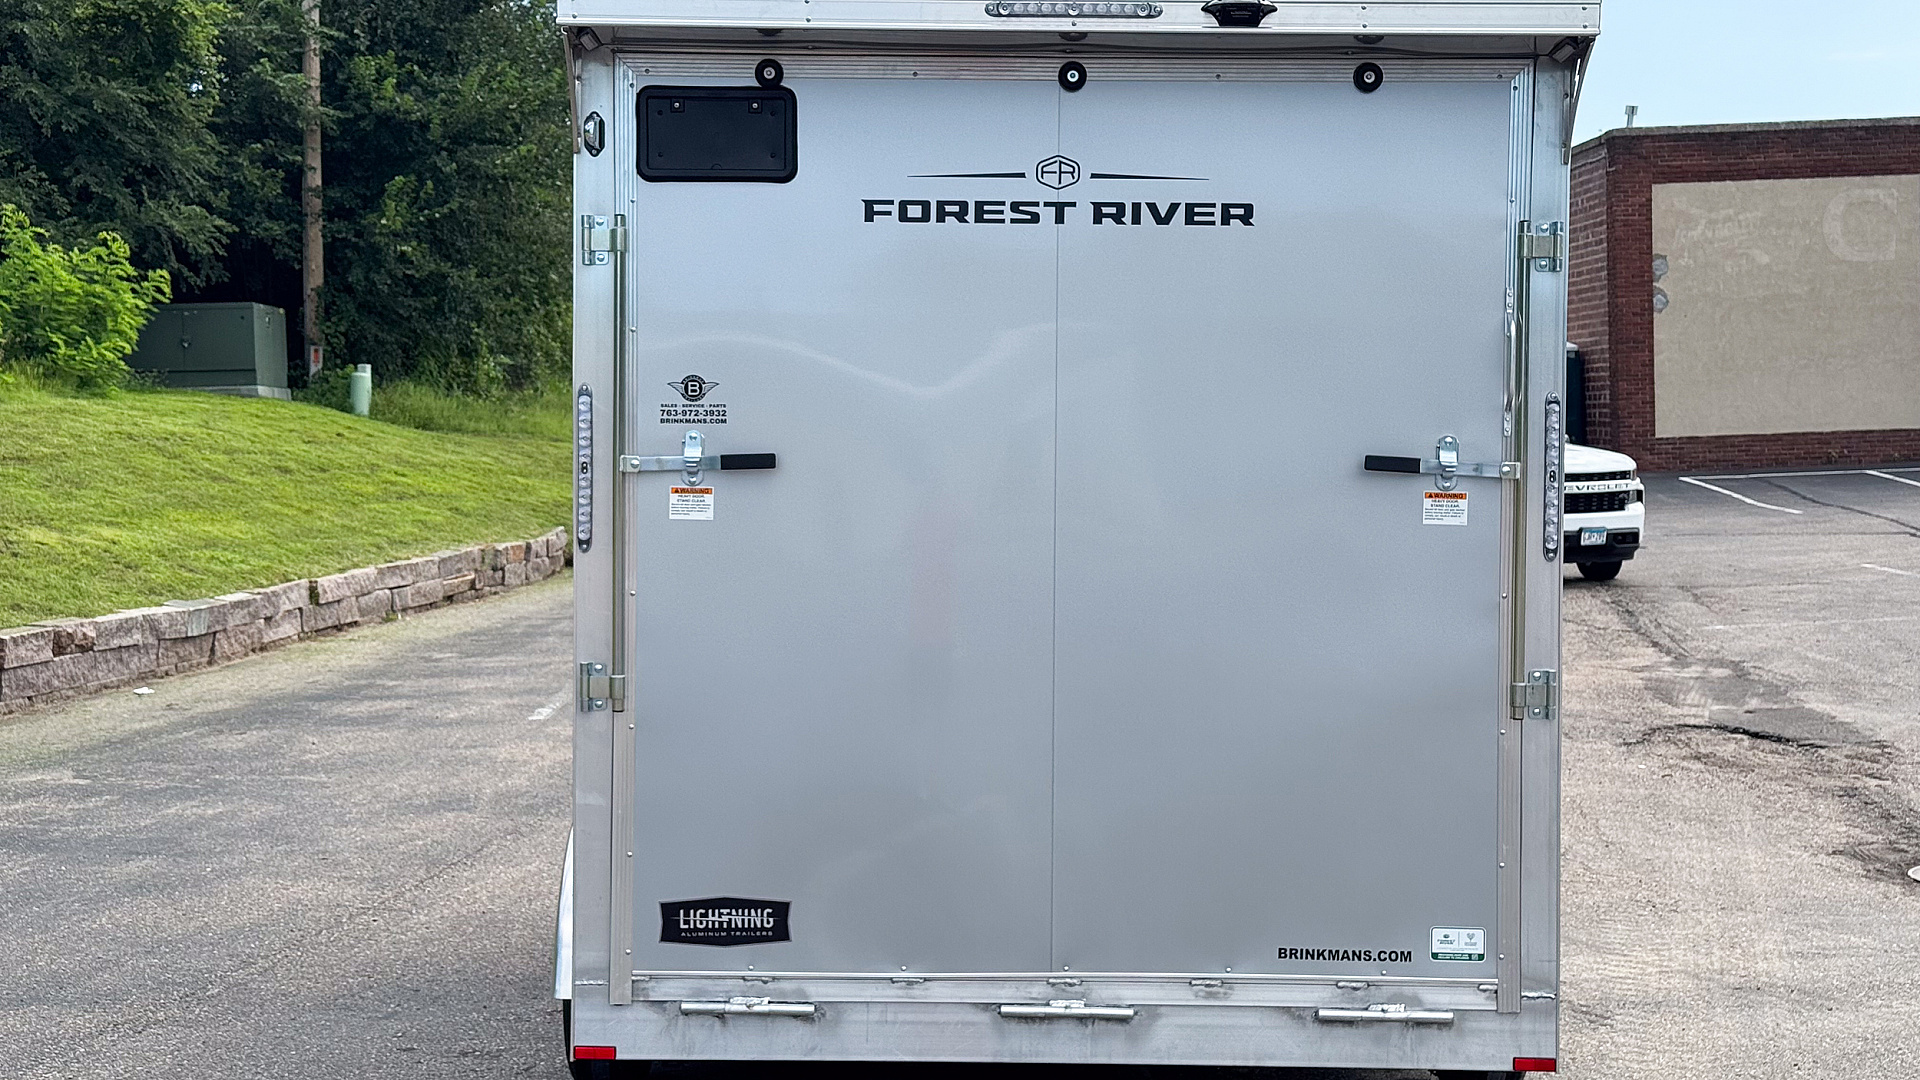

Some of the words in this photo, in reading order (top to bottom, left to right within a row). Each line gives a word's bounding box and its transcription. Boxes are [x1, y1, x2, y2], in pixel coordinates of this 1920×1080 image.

[862, 199, 1077, 225] FOREST
[1089, 201, 1255, 226] RIVER
[687, 381, 700, 395] B
[660, 409, 727, 417] 763-972-3932
[679, 908, 774, 929] LIGHTNING
[1277, 947, 1412, 963] BRINKMANS.COM
